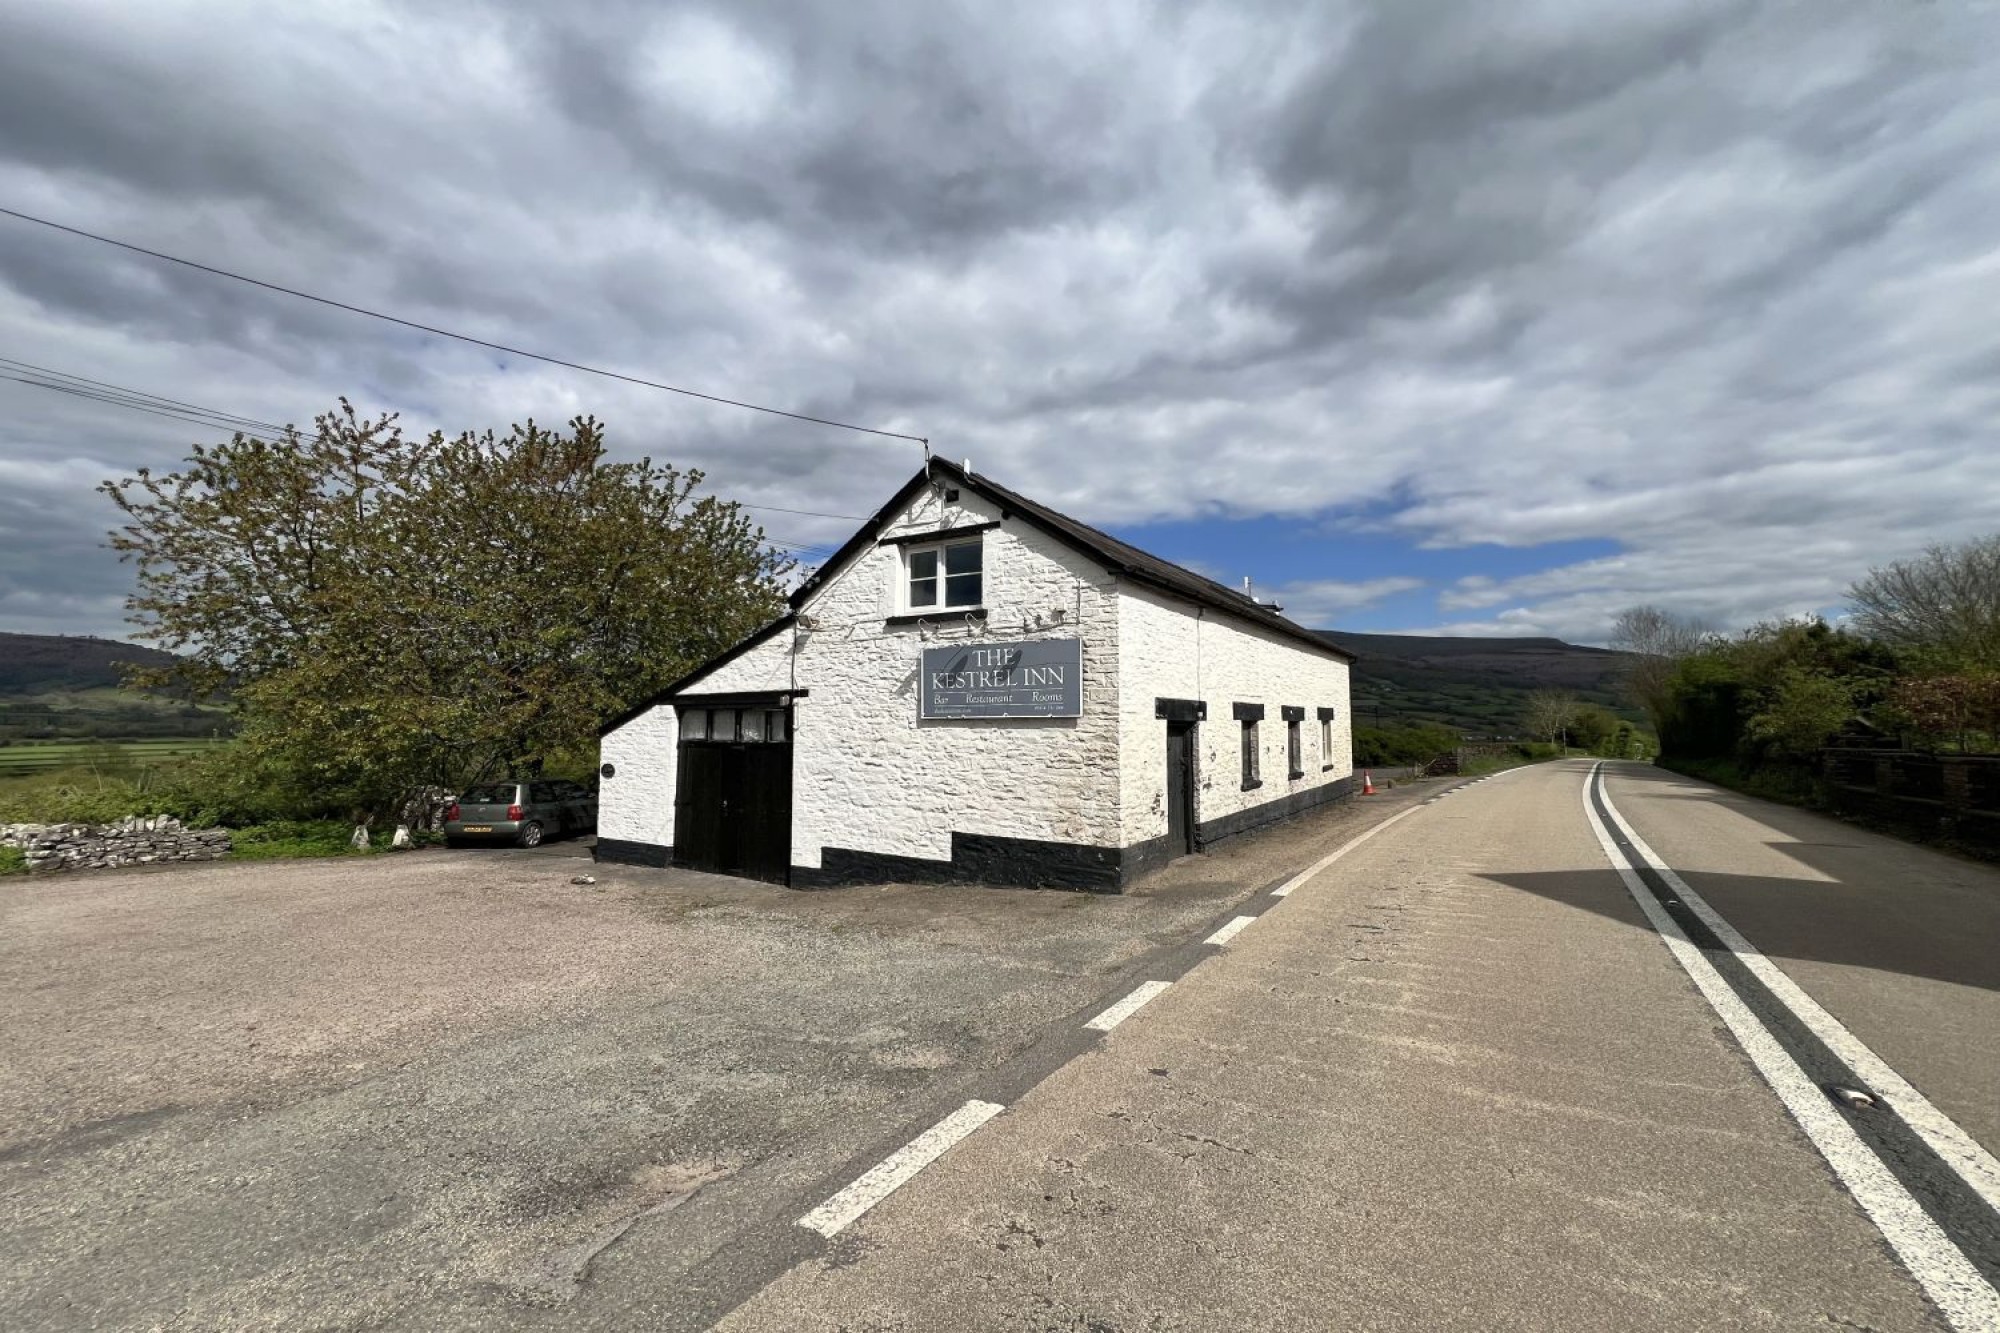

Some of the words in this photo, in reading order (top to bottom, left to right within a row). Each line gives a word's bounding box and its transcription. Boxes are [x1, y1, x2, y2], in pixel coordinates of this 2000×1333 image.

[973, 648, 1015, 667] THE
[932, 669, 1018, 689] KESTREL
[1024, 666, 1065, 686] INN
[934, 694, 949, 705] Bar
[966, 693, 1013, 704] Restaurant
[1032, 691, 1063, 702] Rooms
